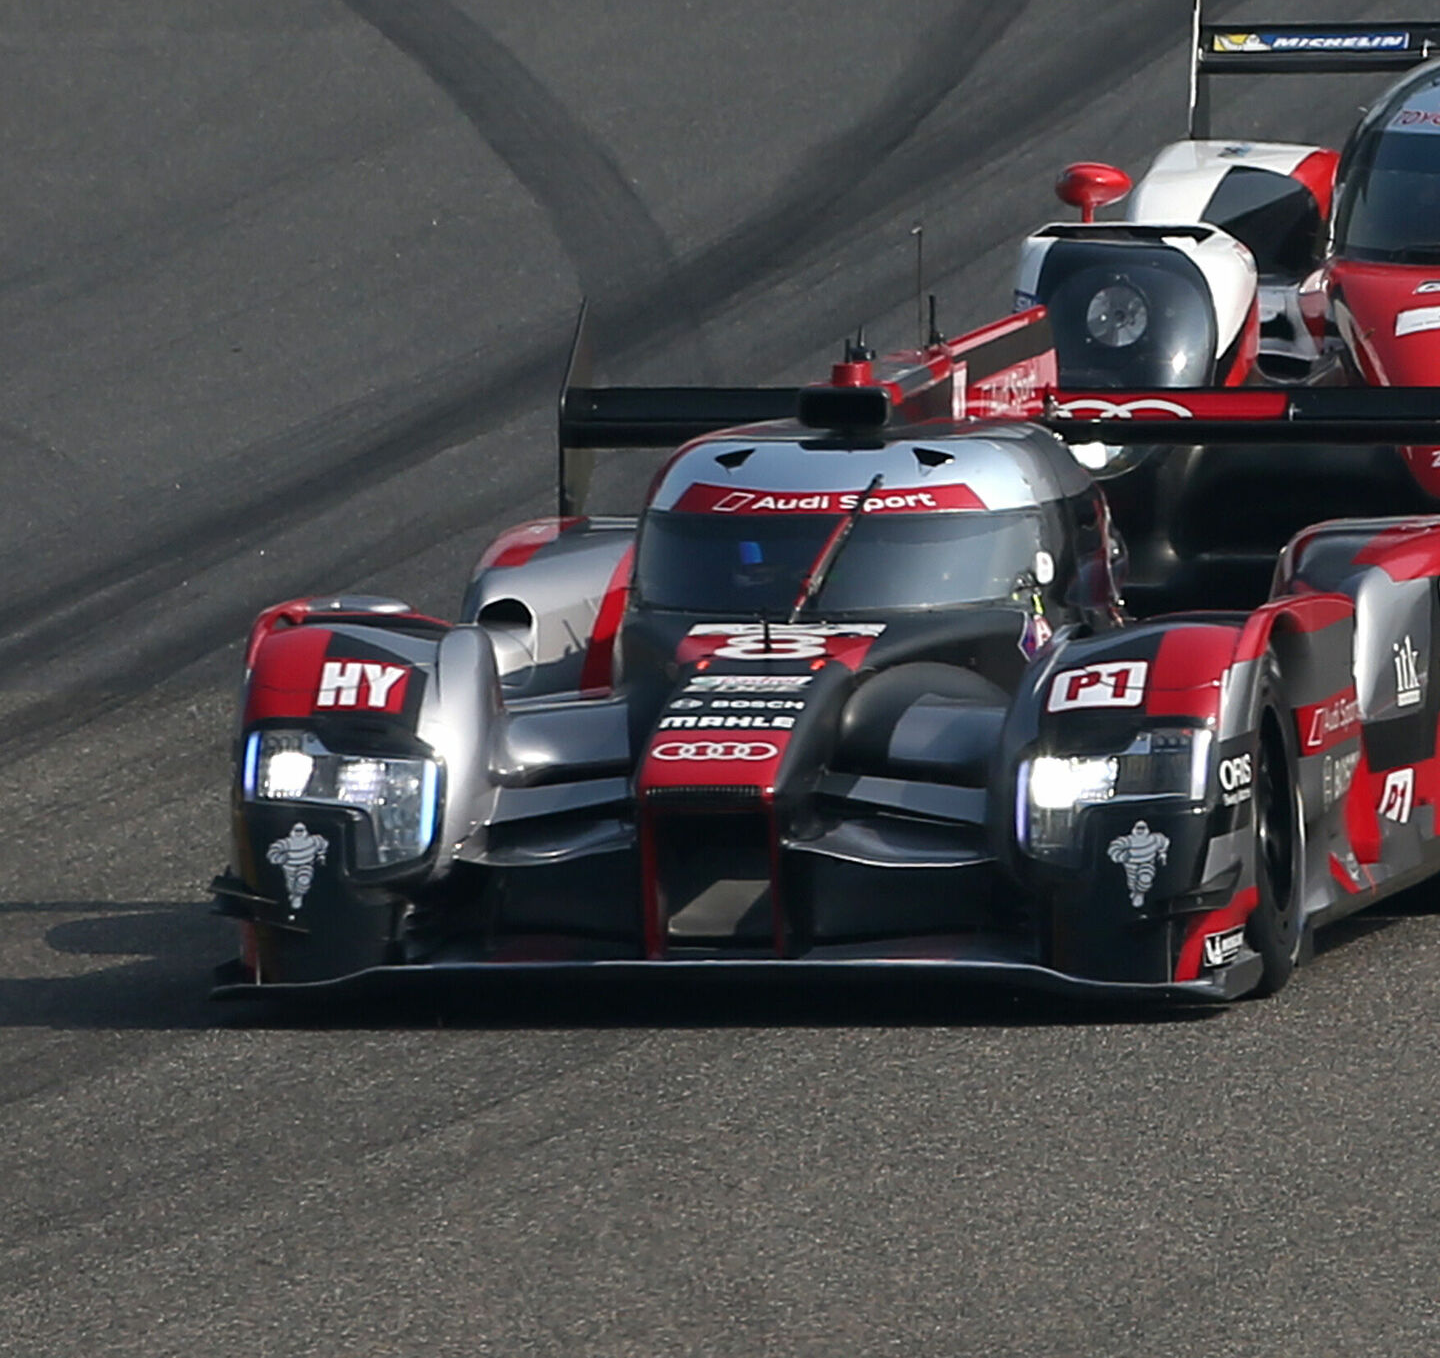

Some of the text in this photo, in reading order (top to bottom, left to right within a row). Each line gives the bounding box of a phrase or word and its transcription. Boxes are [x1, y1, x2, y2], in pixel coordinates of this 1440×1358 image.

[1273, 36, 1404, 48] MICHELIN
[751, 492, 936, 512] Audi Sport
[713, 633, 827, 660] 8
[317, 662, 407, 707] HY
[1065, 668, 1131, 701] P1
[710, 700, 805, 710] BOSCH
[658, 716, 796, 729] MAHLE
